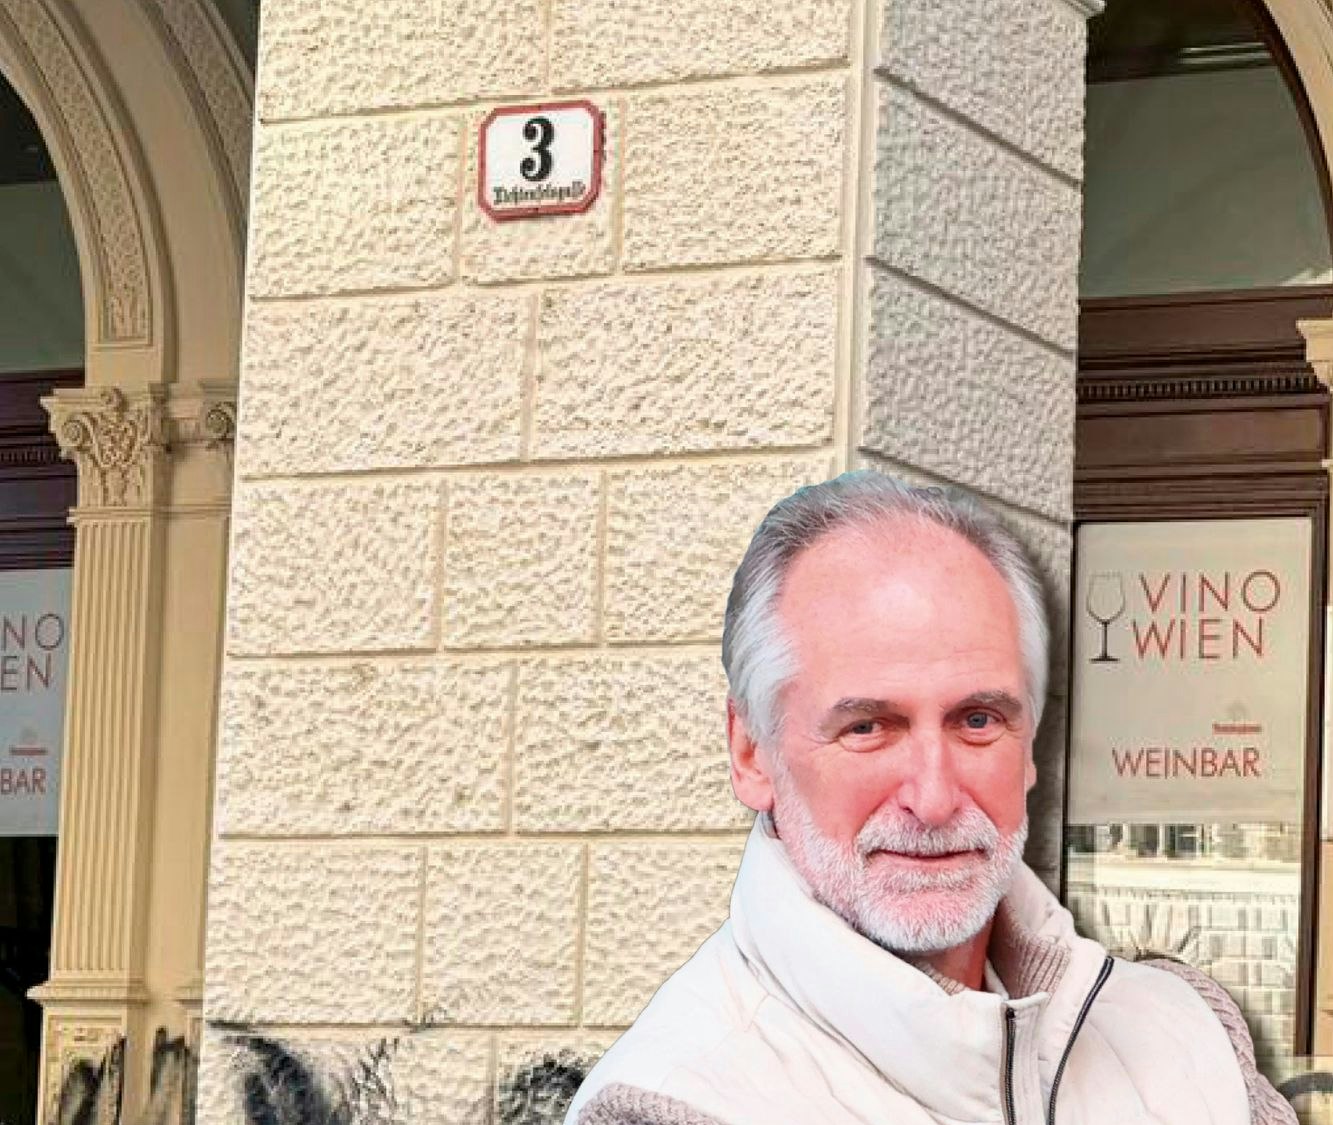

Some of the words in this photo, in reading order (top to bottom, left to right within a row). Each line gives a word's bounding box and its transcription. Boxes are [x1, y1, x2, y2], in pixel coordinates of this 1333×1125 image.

[519, 115, 556, 182] 3
[1139, 569, 1281, 613] VINO
[1131, 617, 1264, 660] WIEN
[1111, 746, 1262, 780] WEINBAR
